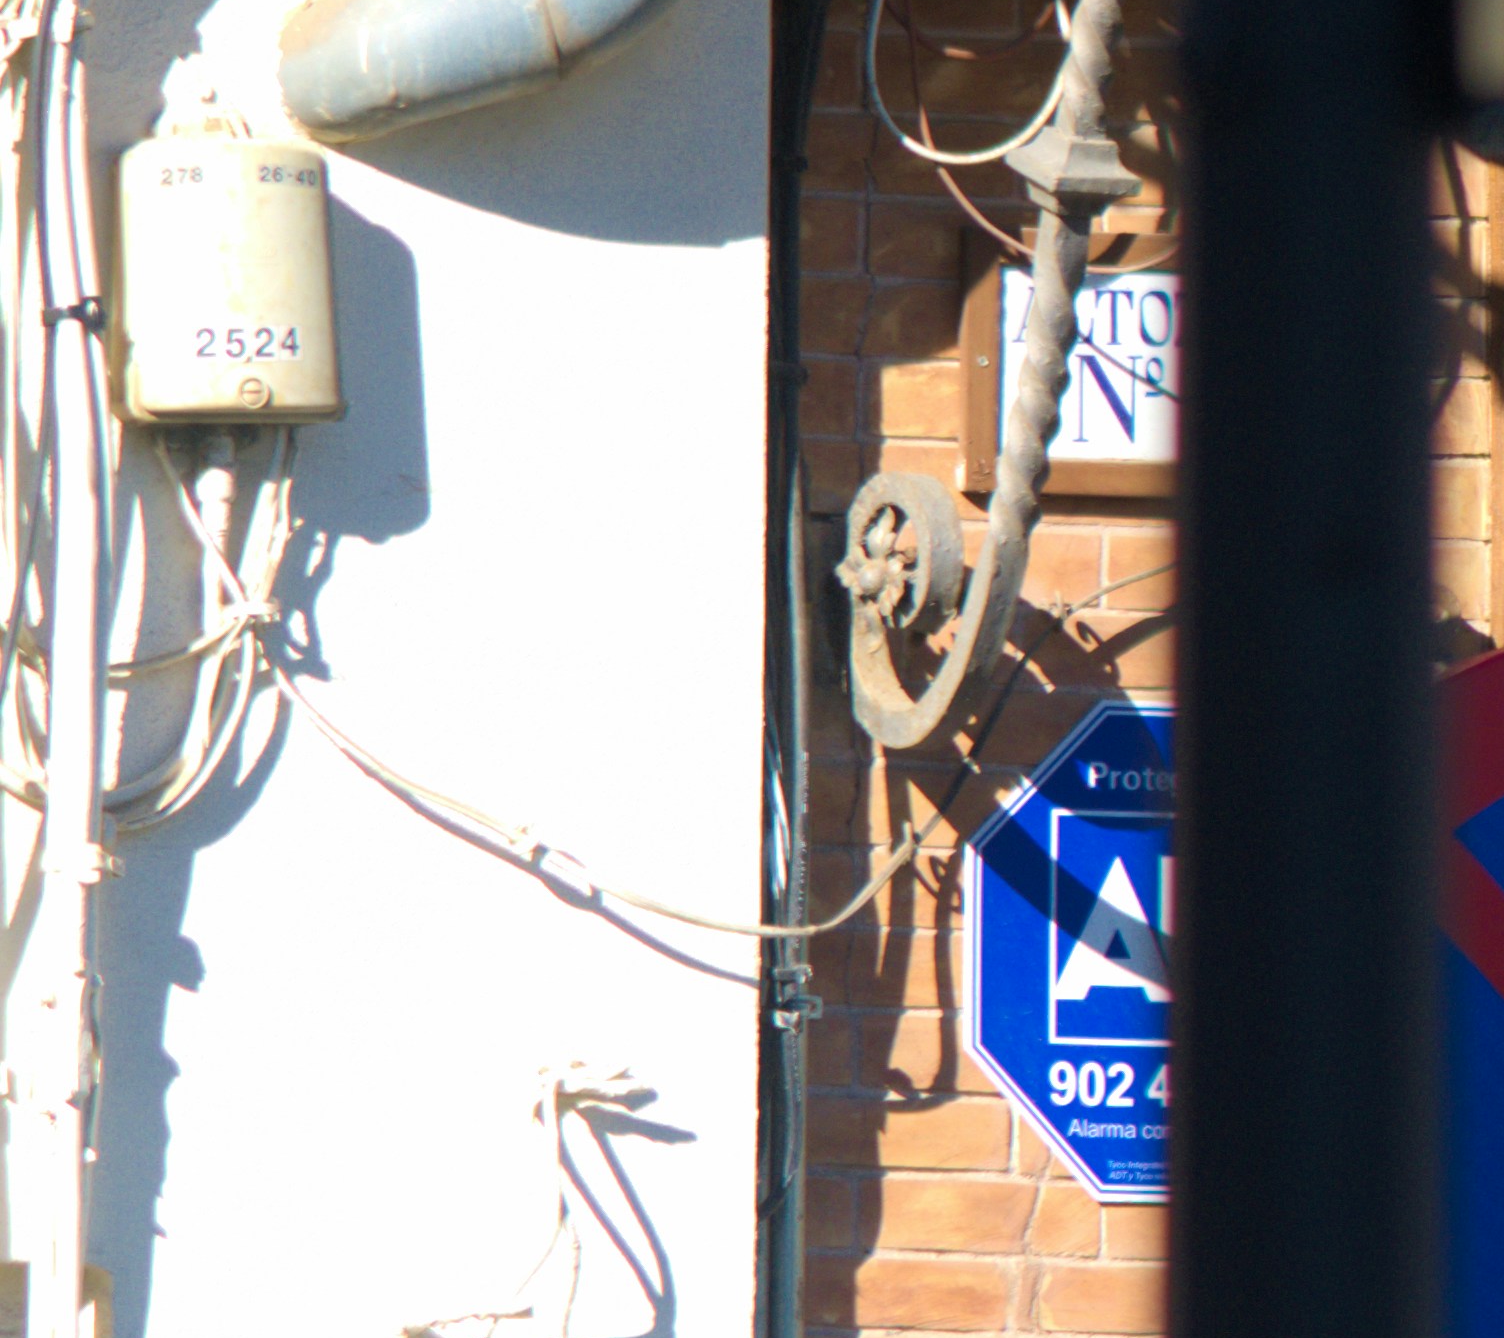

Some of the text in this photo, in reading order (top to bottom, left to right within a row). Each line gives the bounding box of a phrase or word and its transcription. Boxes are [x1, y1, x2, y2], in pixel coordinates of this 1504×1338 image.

[160, 168, 203, 186] 278
[196, 327, 300, 358] 2524
[1087, 761, 1178, 797] Prote
[1049, 1060, 1134, 1107] 902
[1067, 1118, 1137, 1138] Alarma
